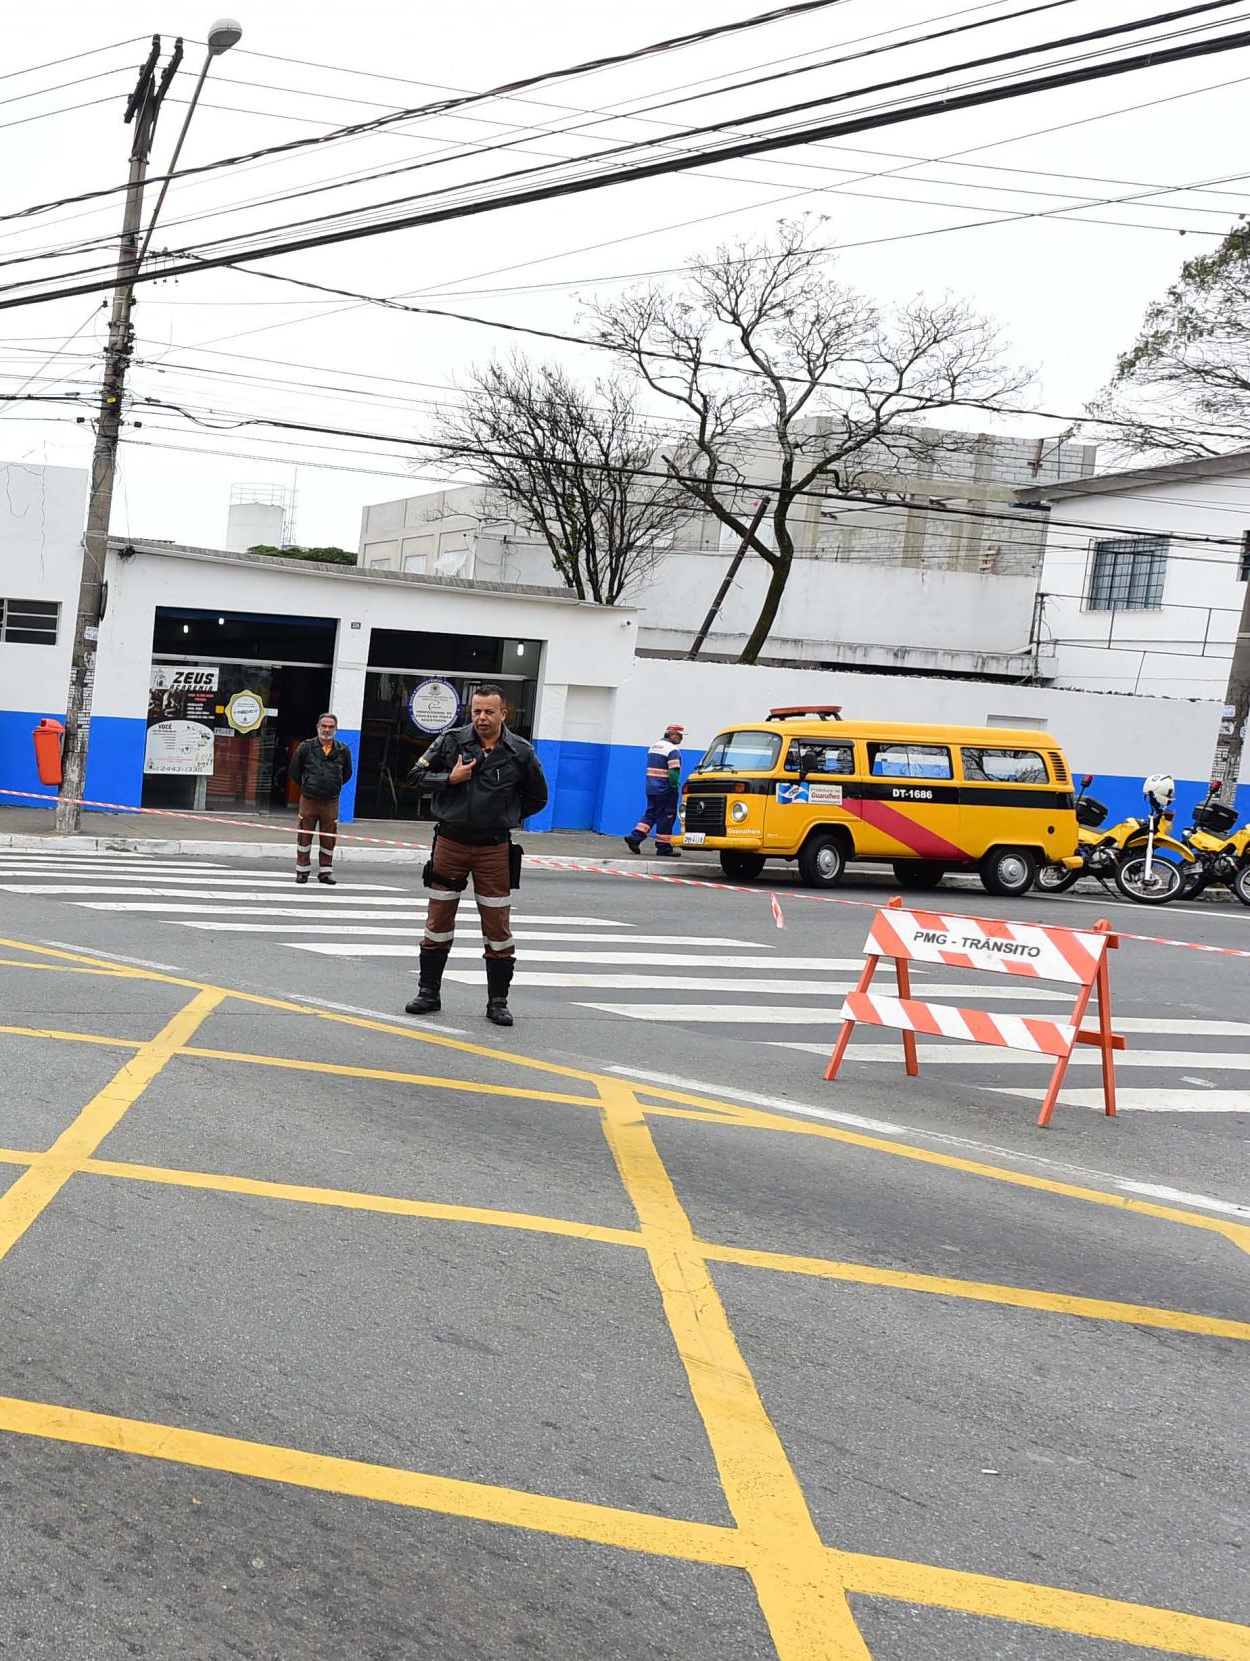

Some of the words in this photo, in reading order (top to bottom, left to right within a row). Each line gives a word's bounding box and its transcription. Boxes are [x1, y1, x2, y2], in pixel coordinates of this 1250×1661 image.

[173, 671, 215, 684] ZEUS
[811, 792, 840, 800] Guarulhos
[892, 788, 933, 799] DT-1686
[913, 931, 948, 946] PMG
[961, 937, 1041, 958] TRÂNSITO
